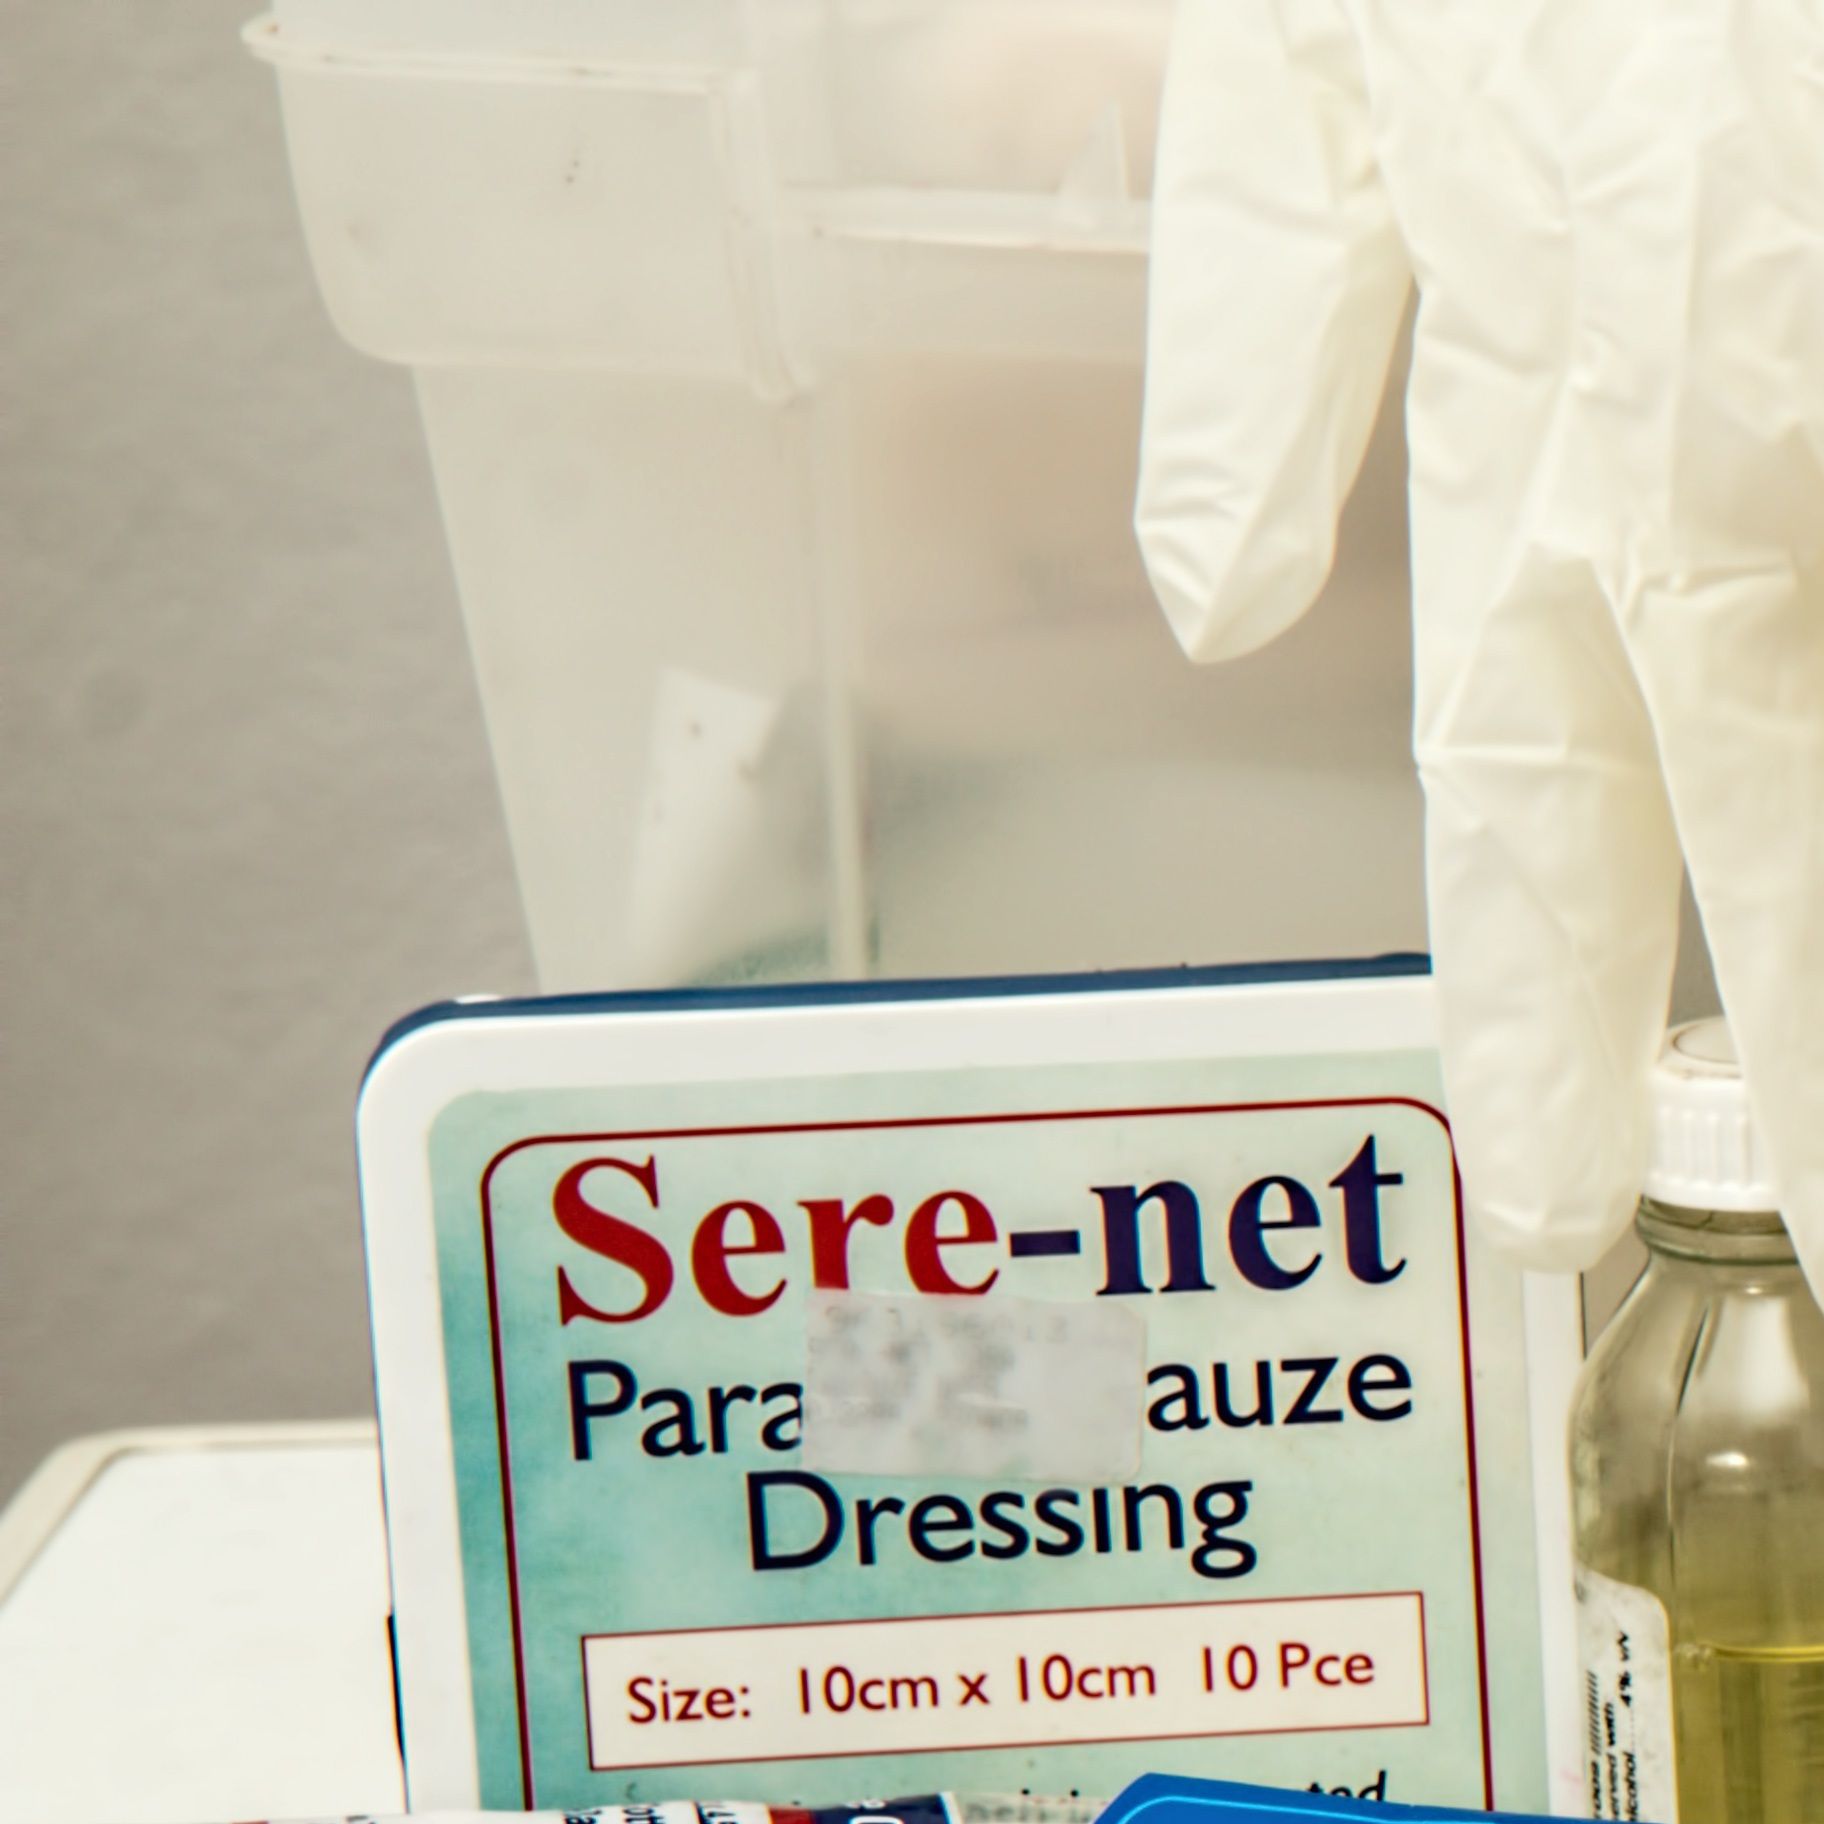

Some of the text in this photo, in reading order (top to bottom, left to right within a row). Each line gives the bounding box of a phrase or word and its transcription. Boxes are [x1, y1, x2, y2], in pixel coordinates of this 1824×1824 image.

[551, 1131, 1407, 1327] Sere-net
[747, 1469, 1259, 1580] Dressing
[625, 1642, 1376, 1725] Size: 10cm x 10cm 10 Pce
